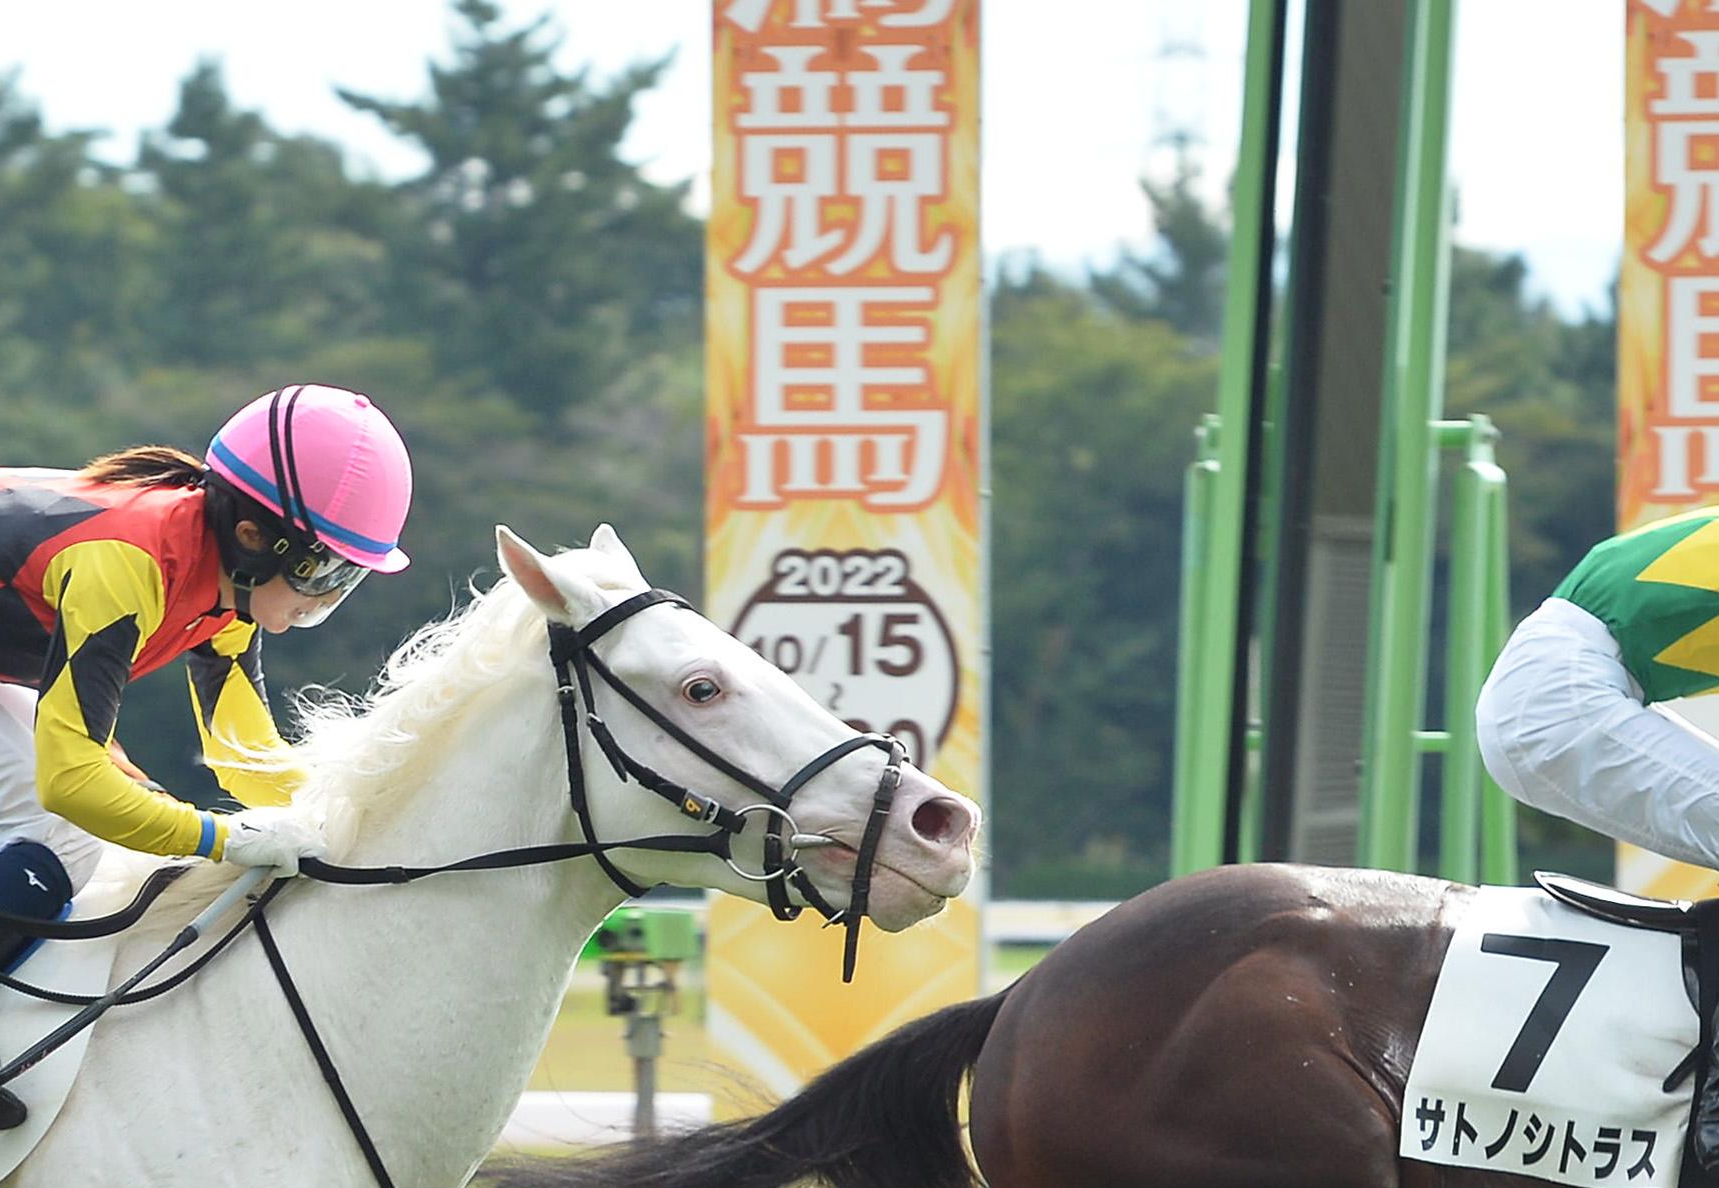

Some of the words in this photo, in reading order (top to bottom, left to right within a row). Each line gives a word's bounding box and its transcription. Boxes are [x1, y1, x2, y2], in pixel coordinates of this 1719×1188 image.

[724, 0, 954, 506] 競馬
[774, 553, 908, 598] 2022
[1480, 933, 1611, 1093] 7
[1415, 1097, 1658, 1181] サトノシトラス
